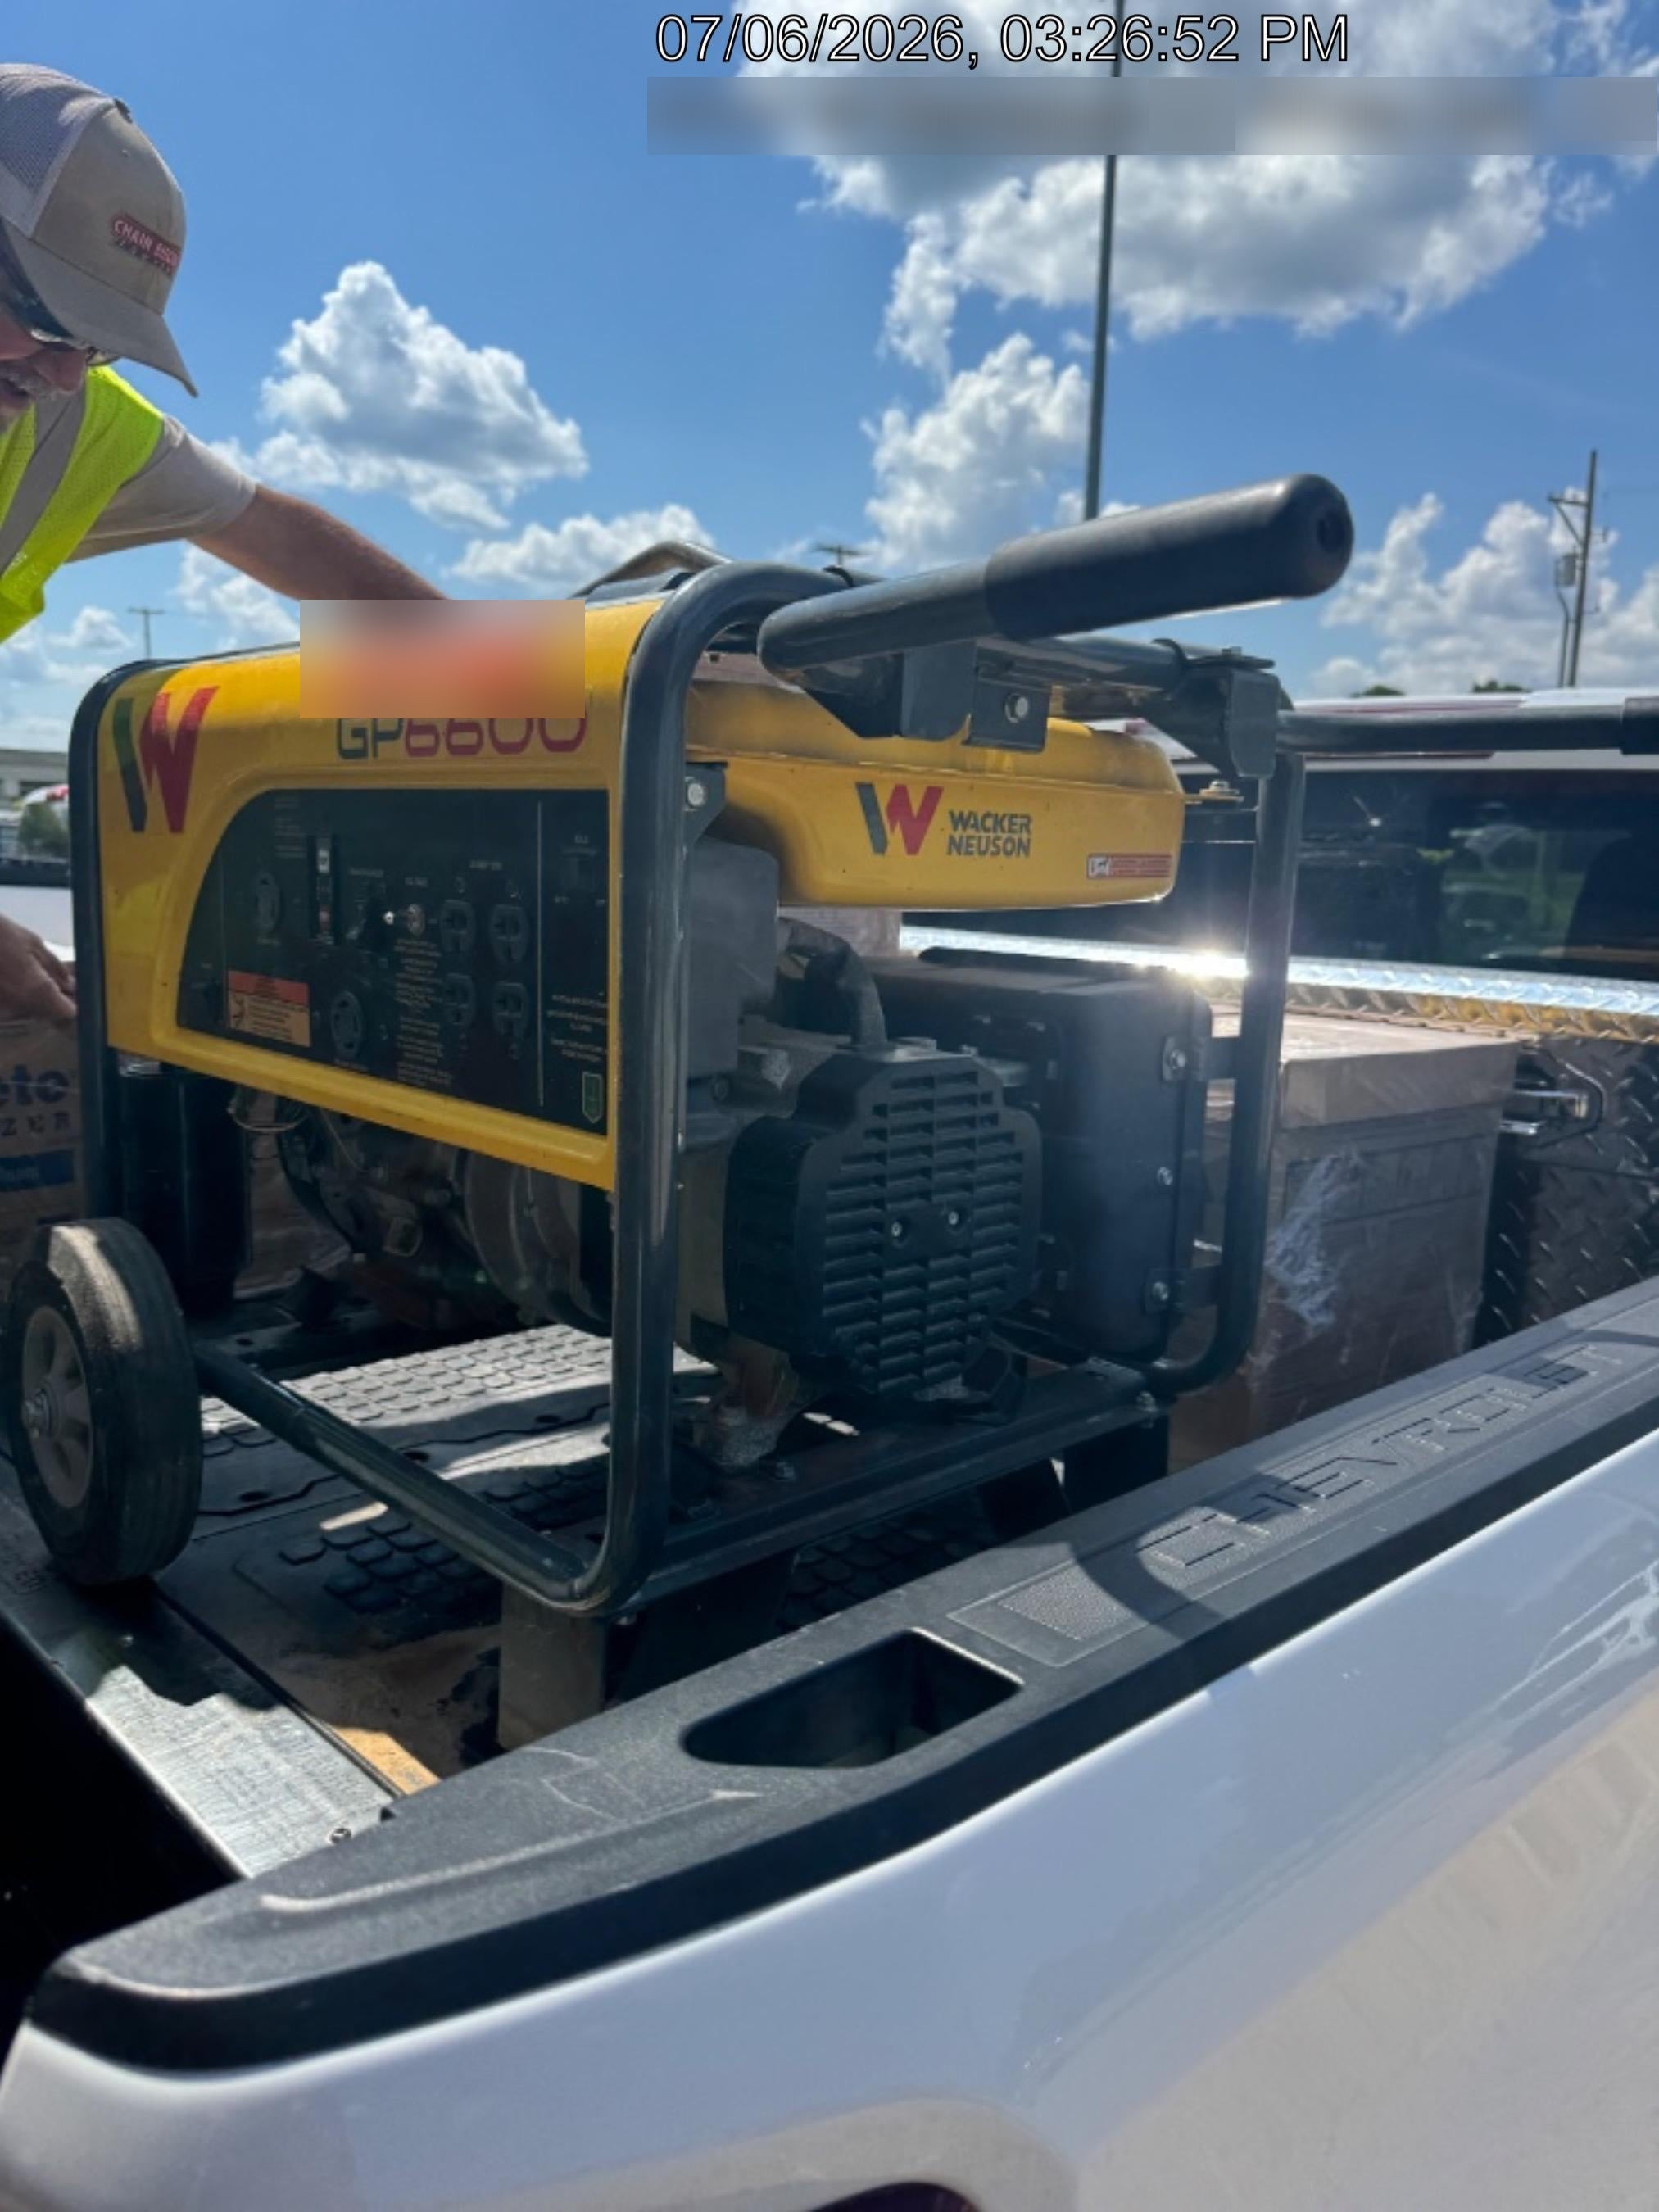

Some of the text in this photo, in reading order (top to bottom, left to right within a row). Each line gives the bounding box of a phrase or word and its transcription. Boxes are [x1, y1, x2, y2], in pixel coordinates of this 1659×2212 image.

[948, 810, 1032, 835] WACKER
[946, 834, 1031, 858] NEUSON
[1135, 1342, 1624, 1568] CHEVROLET
